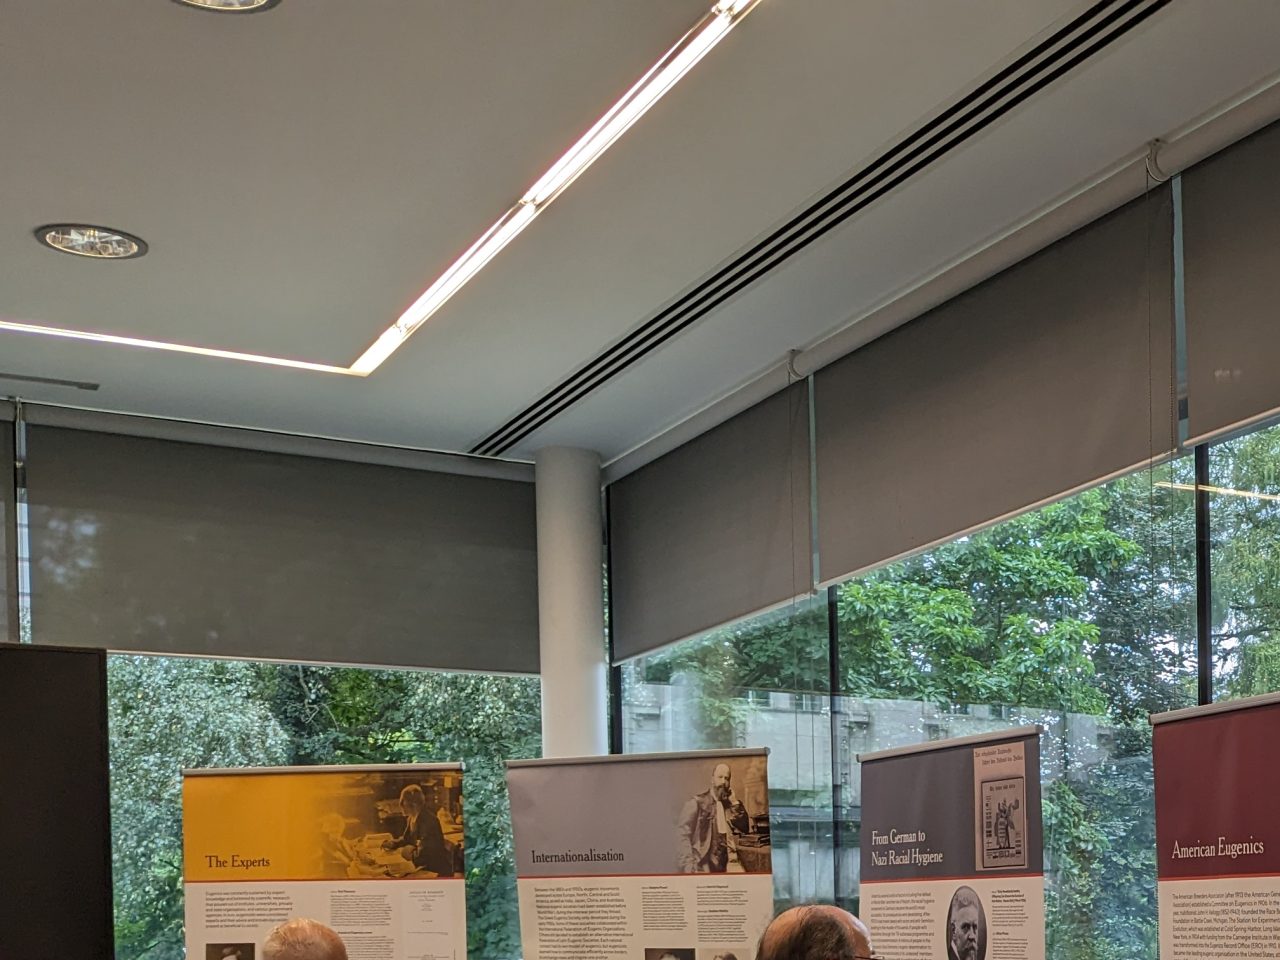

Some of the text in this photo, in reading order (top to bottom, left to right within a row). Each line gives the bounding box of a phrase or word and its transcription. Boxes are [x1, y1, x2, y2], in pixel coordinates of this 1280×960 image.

[872, 829, 925, 845] From German to
[1172, 835, 1264, 859] American Eugenics
[205, 854, 271, 869] The Experts
[532, 848, 624, 863] Internationalisation
[872, 848, 943, 866] Nazi Racial Hygiene
